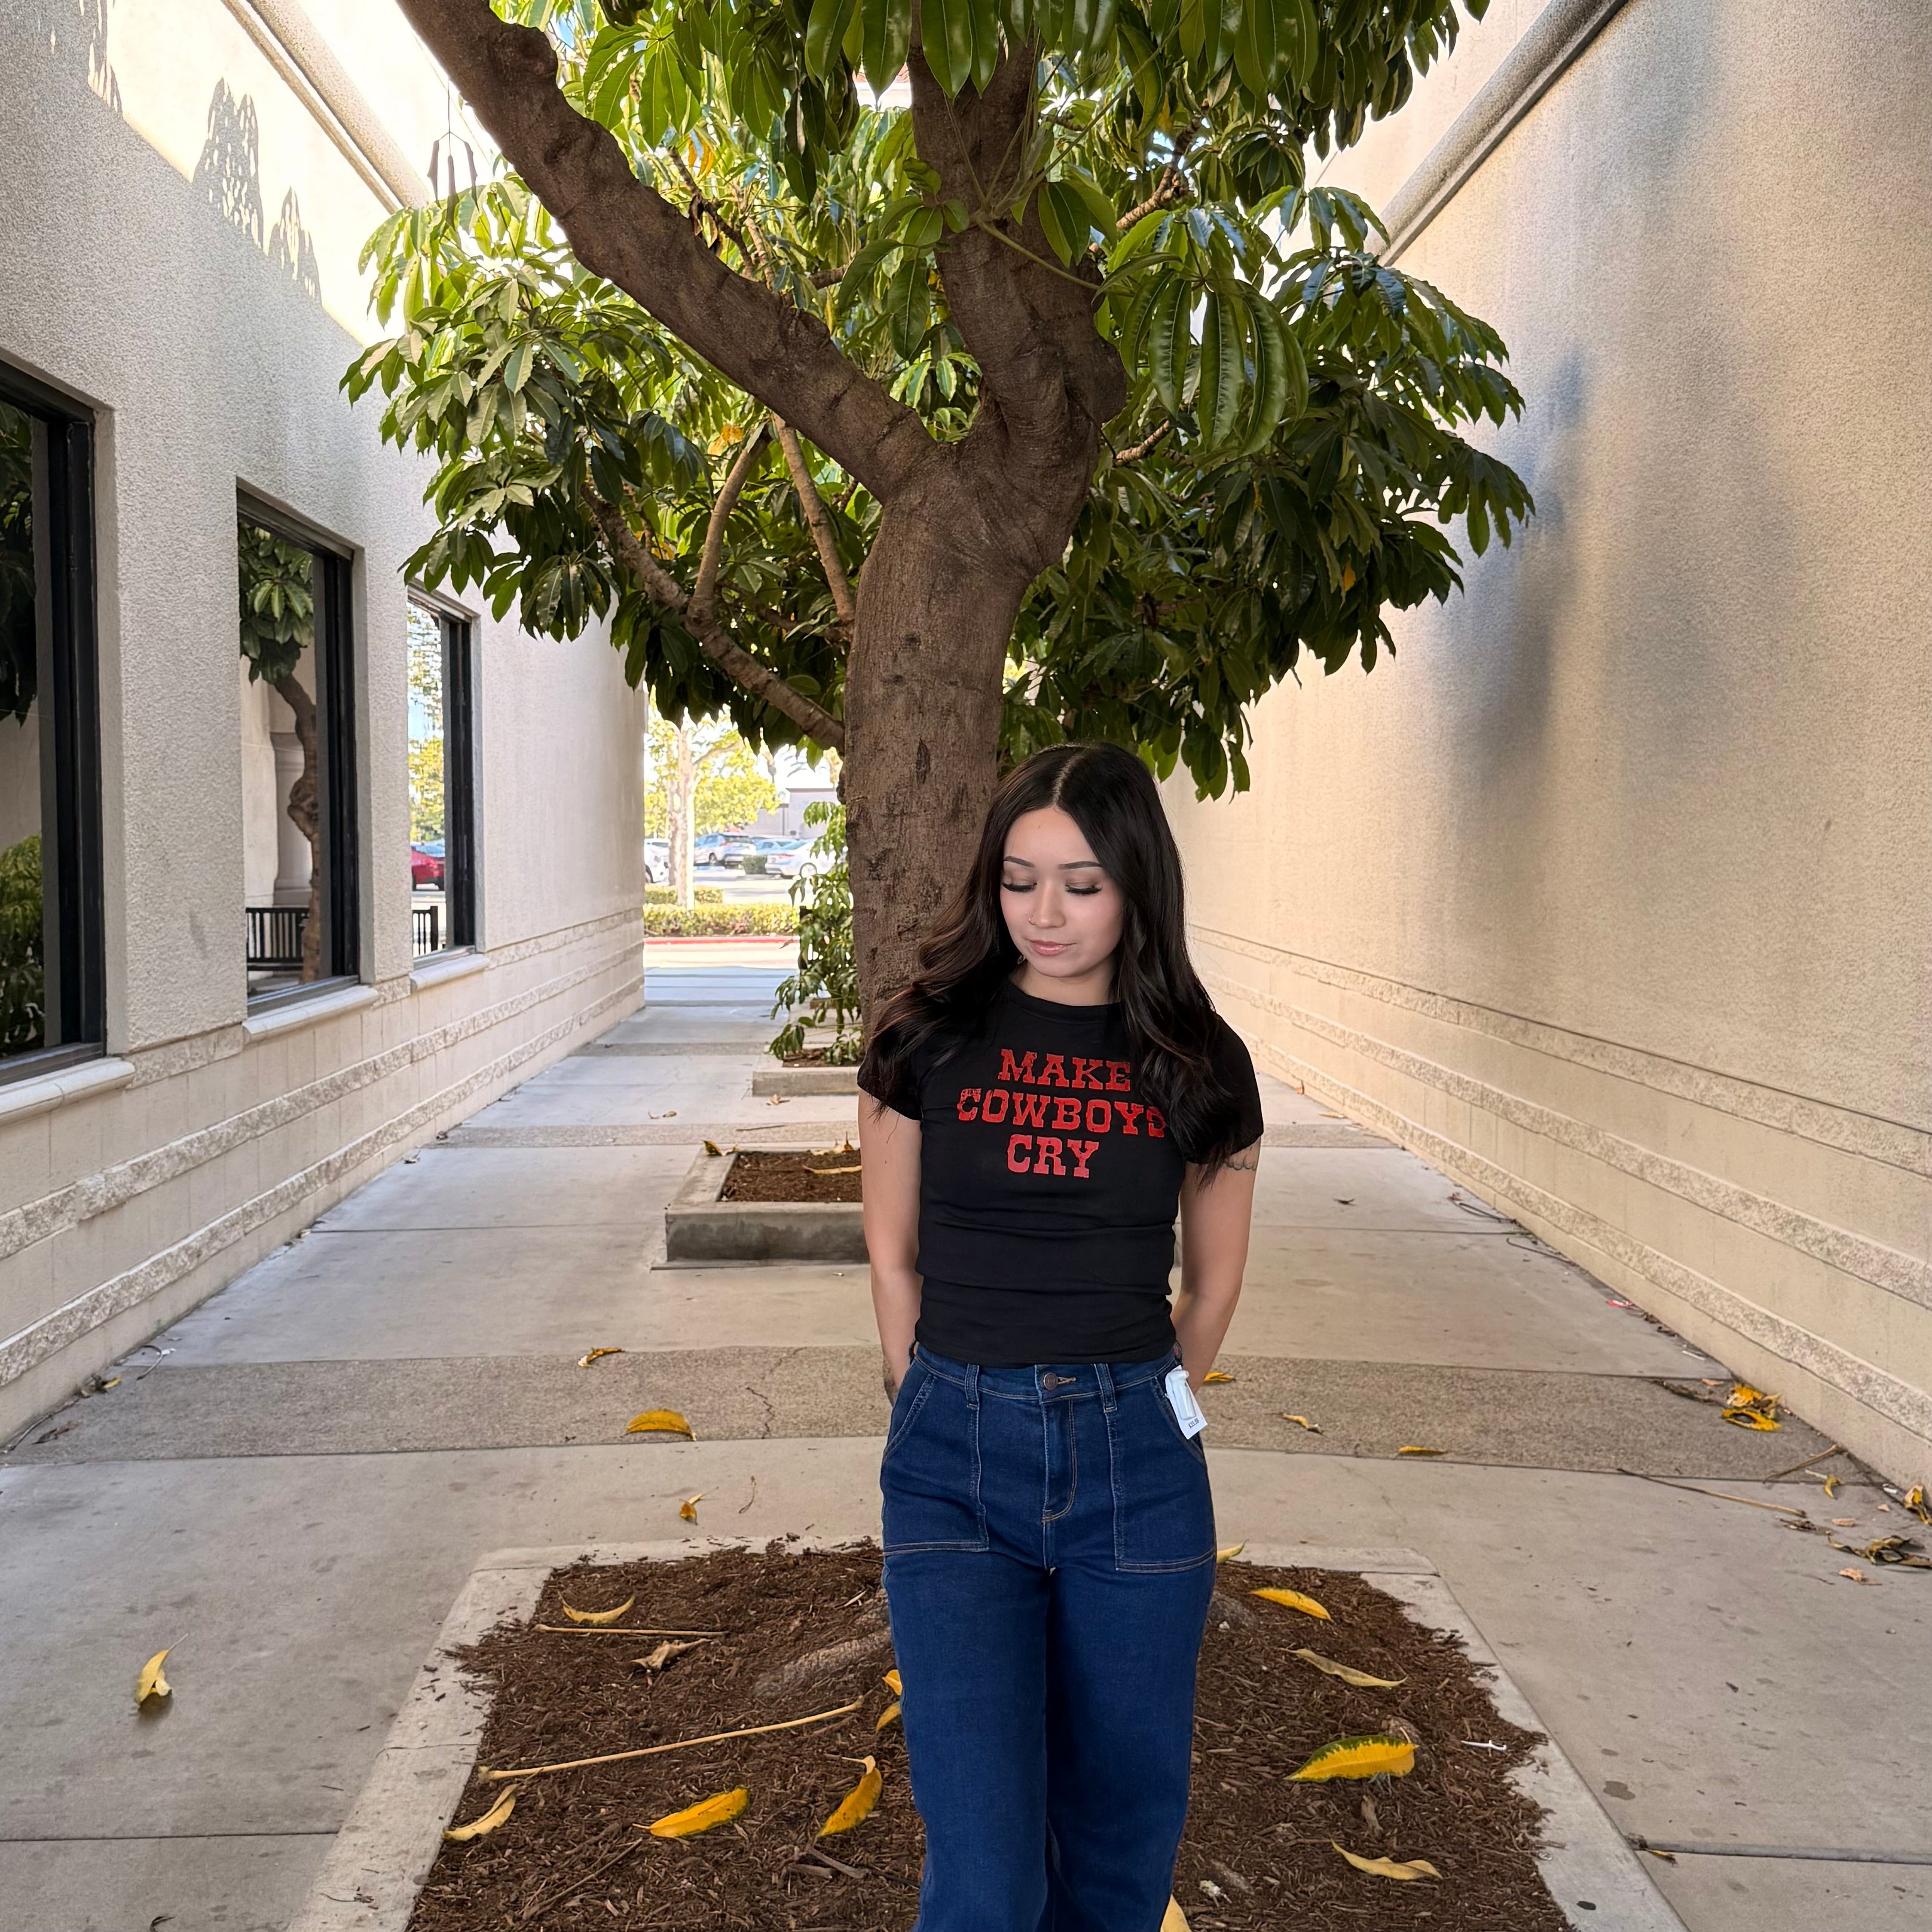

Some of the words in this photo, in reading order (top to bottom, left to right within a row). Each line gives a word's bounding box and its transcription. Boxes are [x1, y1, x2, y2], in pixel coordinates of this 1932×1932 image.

[997, 1048, 1131, 1093] MAKE
[956, 1088, 1165, 1138] COWBOYS
[1007, 1133, 1100, 1179] CRY
